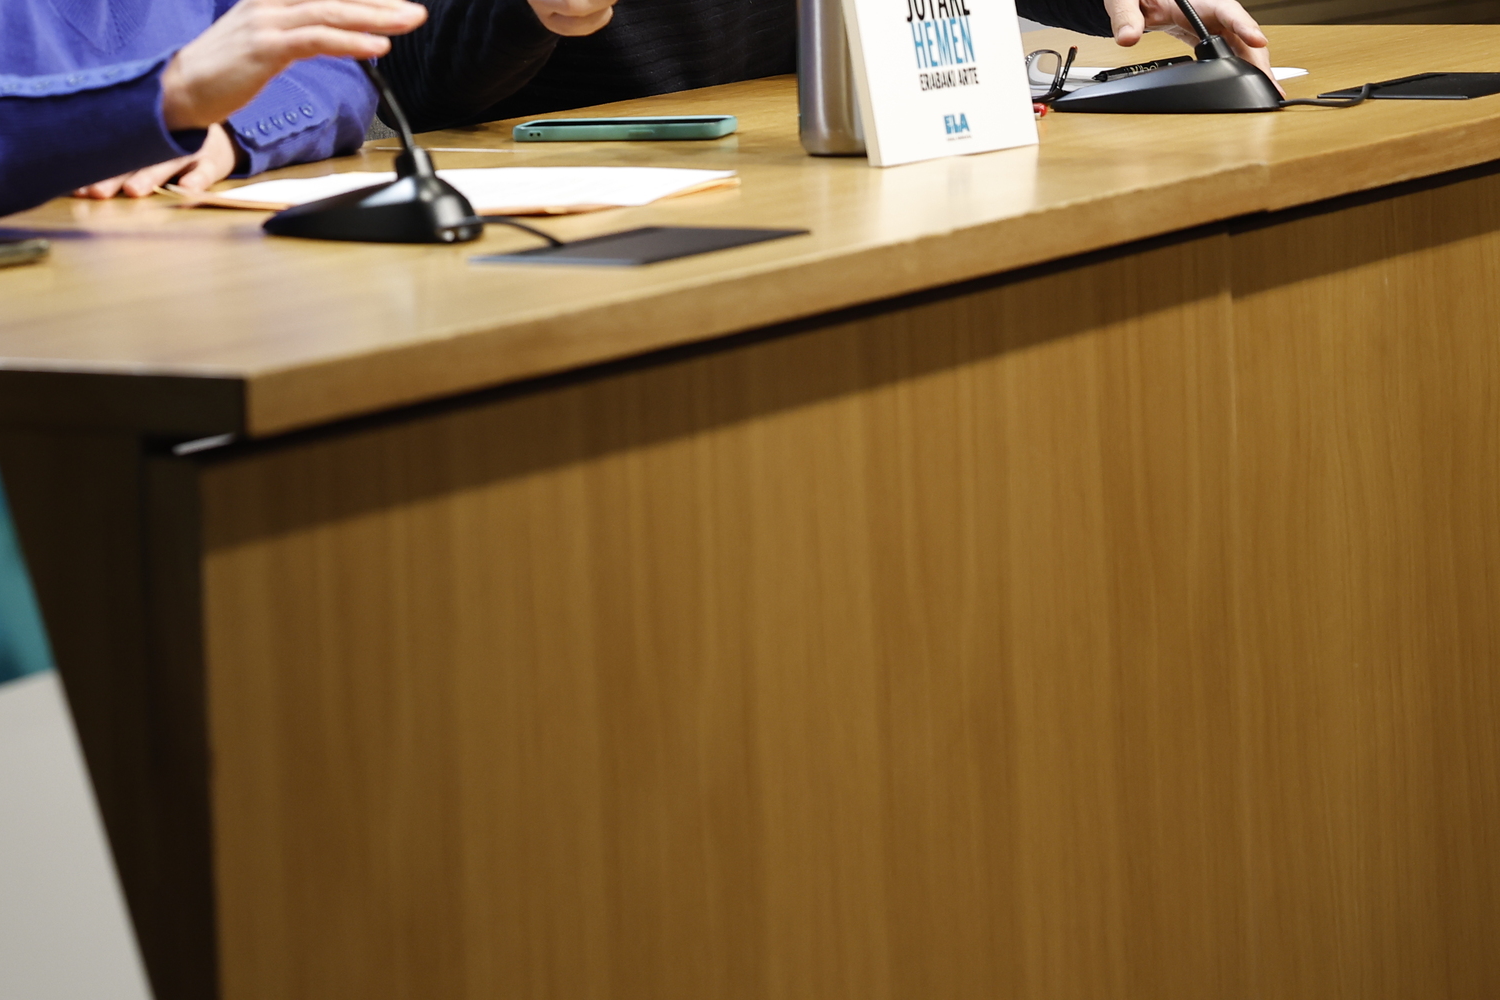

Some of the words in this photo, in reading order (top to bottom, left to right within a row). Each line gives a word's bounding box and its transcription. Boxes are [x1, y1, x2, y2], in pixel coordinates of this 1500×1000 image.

[910, 16, 976, 68] HEMEN
[920, 70, 956, 91] ERABAKI
[957, 67, 979, 87] ARTE
[944, 113, 970, 134] ELA
